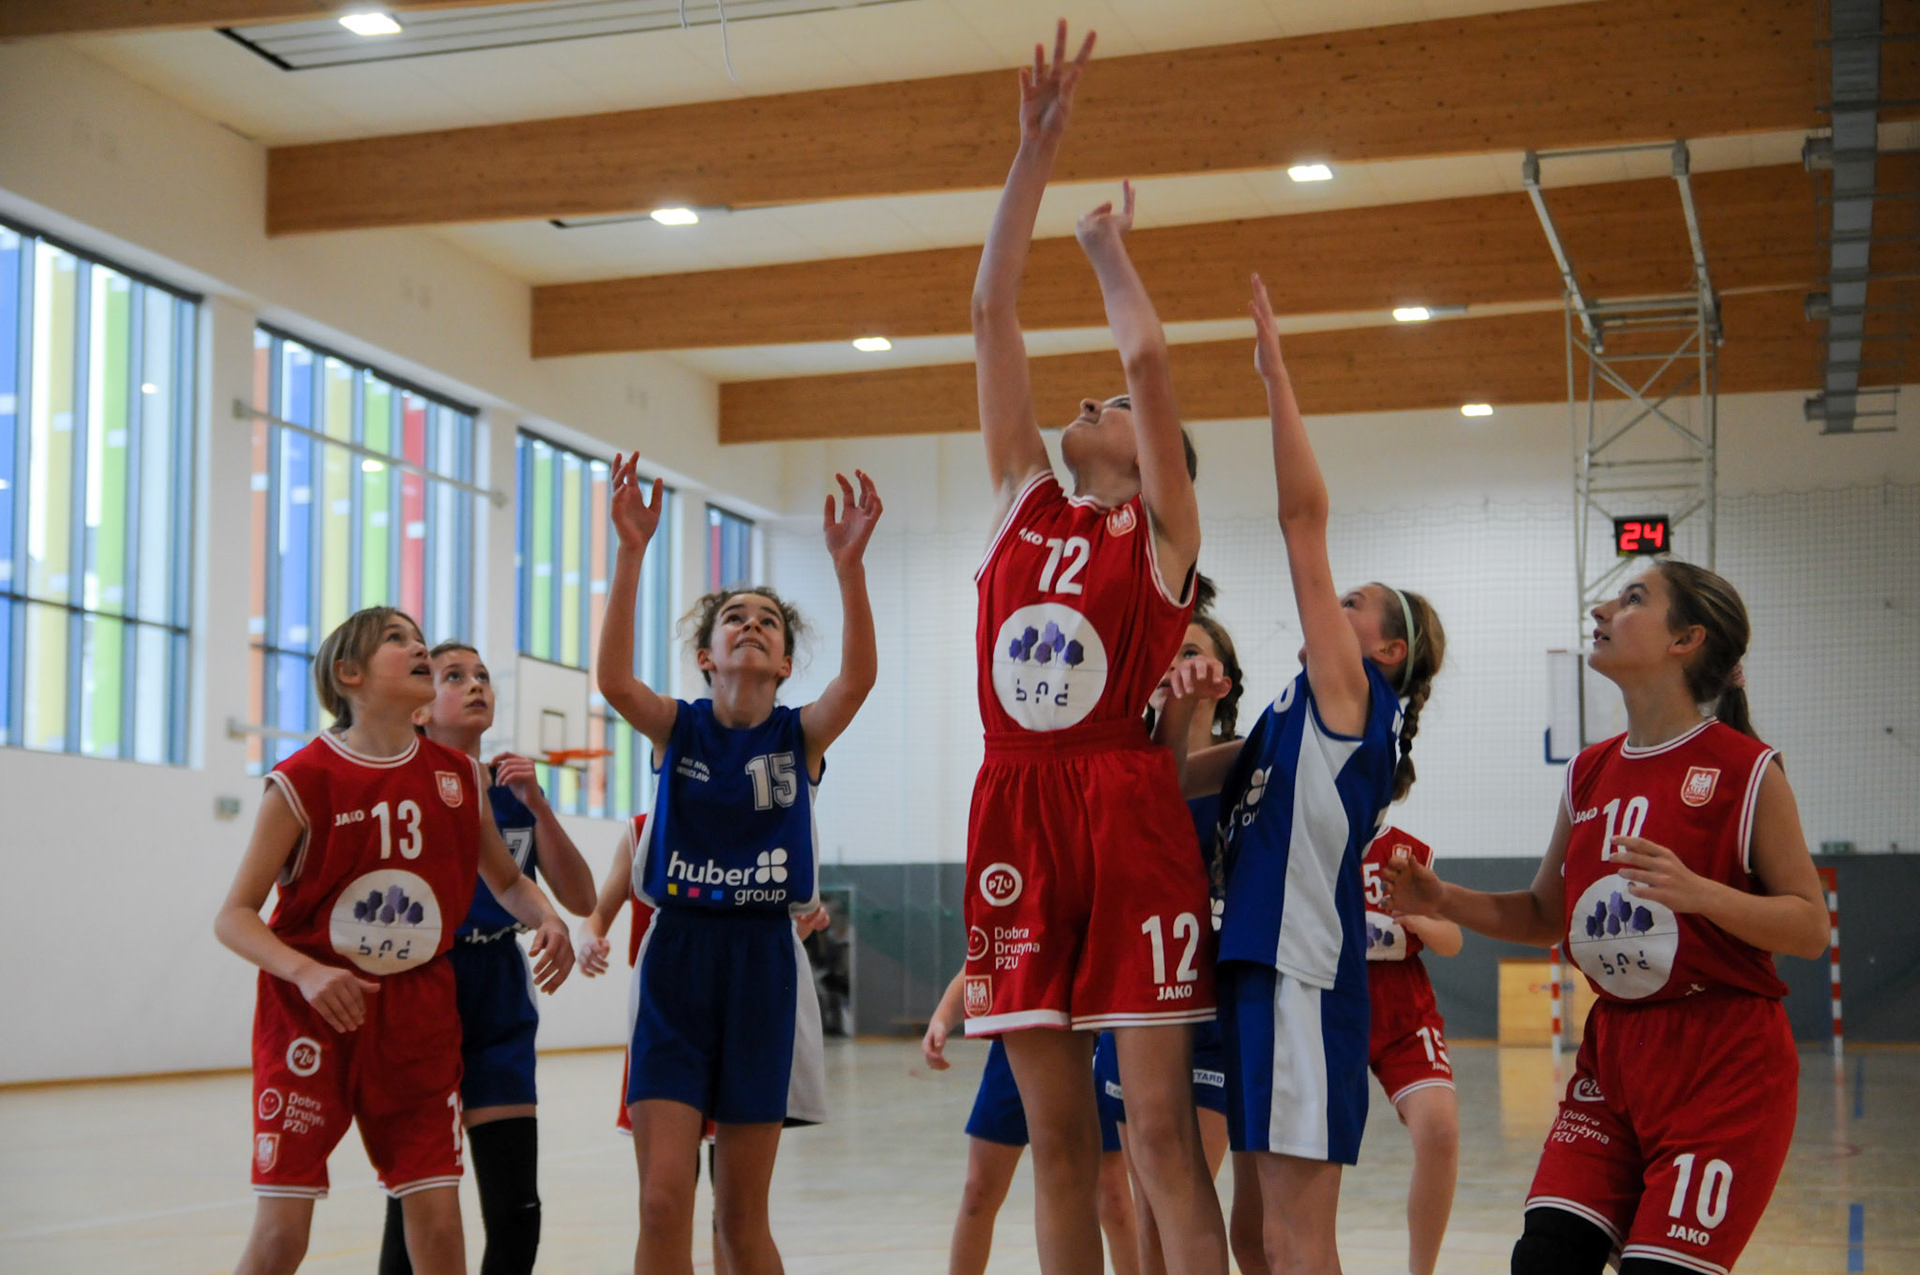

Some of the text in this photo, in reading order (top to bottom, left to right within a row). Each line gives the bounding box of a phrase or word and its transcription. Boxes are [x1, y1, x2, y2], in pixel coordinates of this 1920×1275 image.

[1619, 521, 1665, 551] 24
[1037, 535, 1091, 596] 12
[744, 751, 798, 811] 15
[370, 799, 423, 861] 13
[1601, 795, 1650, 862] 10
[667, 850, 755, 887] huber
[734, 888, 787, 906] group
[988, 874, 1014, 896] PZU
[994, 926, 1030, 941] Dobra
[1141, 911, 1200, 985] 12
[995, 956, 1019, 970] PZU
[1156, 984, 1193, 1001] JAKO
[287, 1092, 322, 1111] Dobra
[282, 1118, 308, 1134] PZU
[1562, 1109, 1601, 1127] Dobra
[1551, 1130, 1578, 1144] PZU
[1556, 1119, 1611, 1146] Drużyna
[1667, 1152, 1734, 1230] 10
[1666, 1223, 1711, 1247] JAKO
